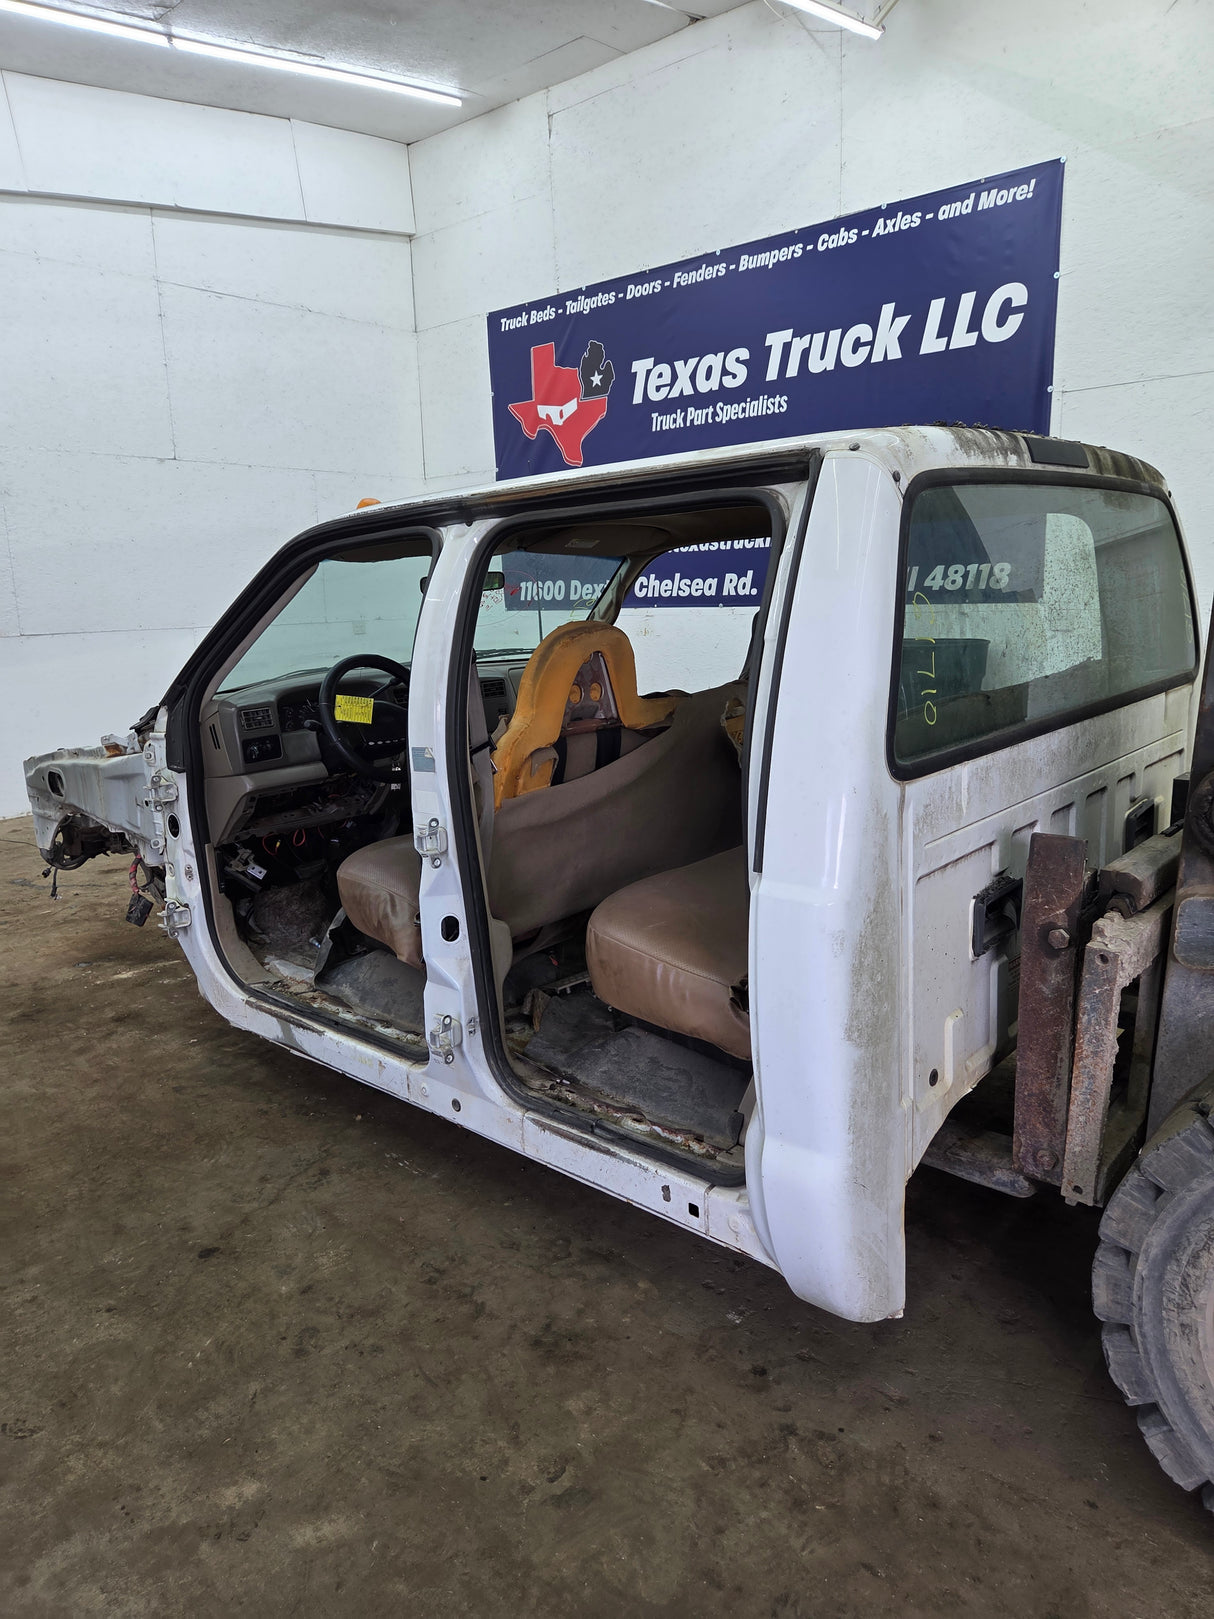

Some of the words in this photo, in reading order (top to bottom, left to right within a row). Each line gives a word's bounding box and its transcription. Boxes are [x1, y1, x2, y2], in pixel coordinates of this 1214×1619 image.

[500, 312, 529, 332] Truck
[529, 305, 556, 325] Beds
[565, 291, 616, 316] Tailgates
[625, 280, 662, 300] Doors
[673, 263, 727, 288] Fenders
[738, 244, 804, 272] Bumpers
[817, 227, 859, 252] Cabs
[872, 211, 923, 238] Axles
[937, 193, 976, 221] and
[976, 178, 1037, 211] More!
[630, 347, 751, 405] Texas
[764, 301, 912, 382] Truck
[918, 281, 1029, 355] LLC
[651, 408, 685, 432] Truck
[686, 401, 714, 427] Part
[714, 394, 789, 423] Specialists
[519, 579, 566, 601] 11600
[634, 573, 718, 598] Chelsea
[722, 570, 758, 596] Rd.
[924, 562, 1012, 591] 48118
